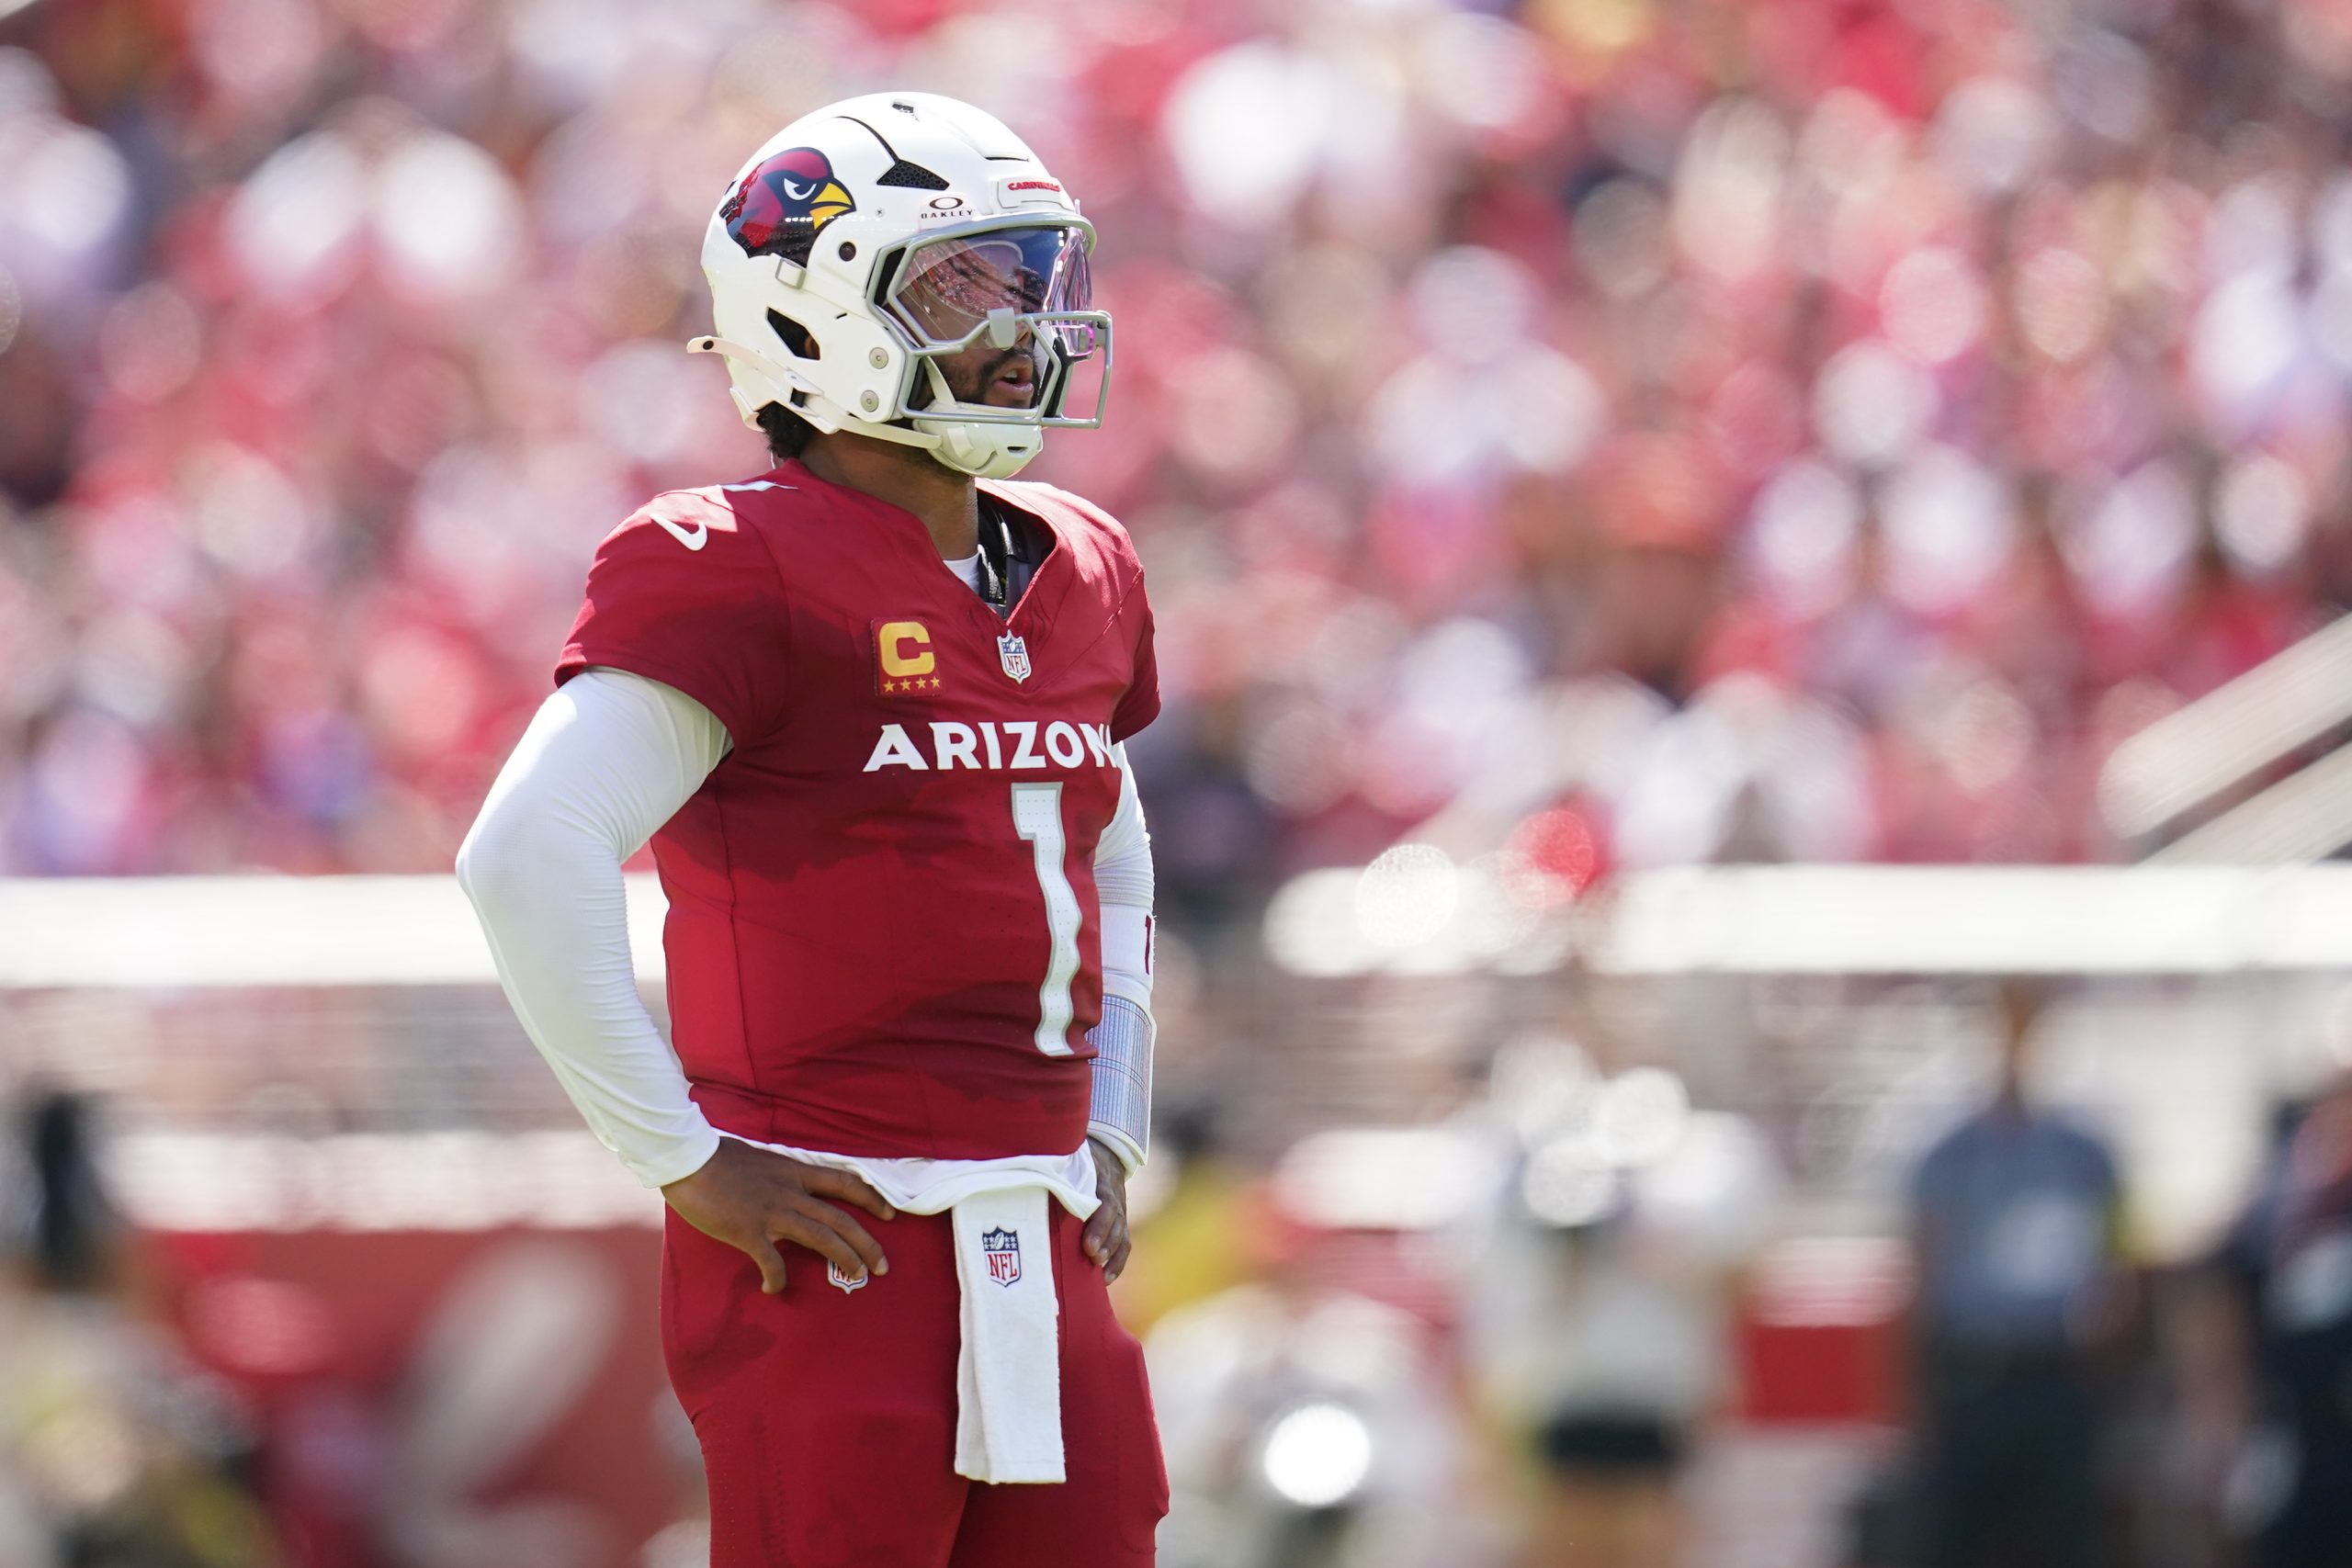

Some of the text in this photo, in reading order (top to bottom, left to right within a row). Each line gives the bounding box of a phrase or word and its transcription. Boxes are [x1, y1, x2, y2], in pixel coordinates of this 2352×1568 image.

[921, 209, 972, 220] OAKLEY
[878, 621, 935, 678] C
[1006, 655, 1026, 673] NFL
[862, 720, 1117, 773] ARIZON
[1011, 782, 1083, 1056] 1
[987, 1253, 1018, 1280] NFL
